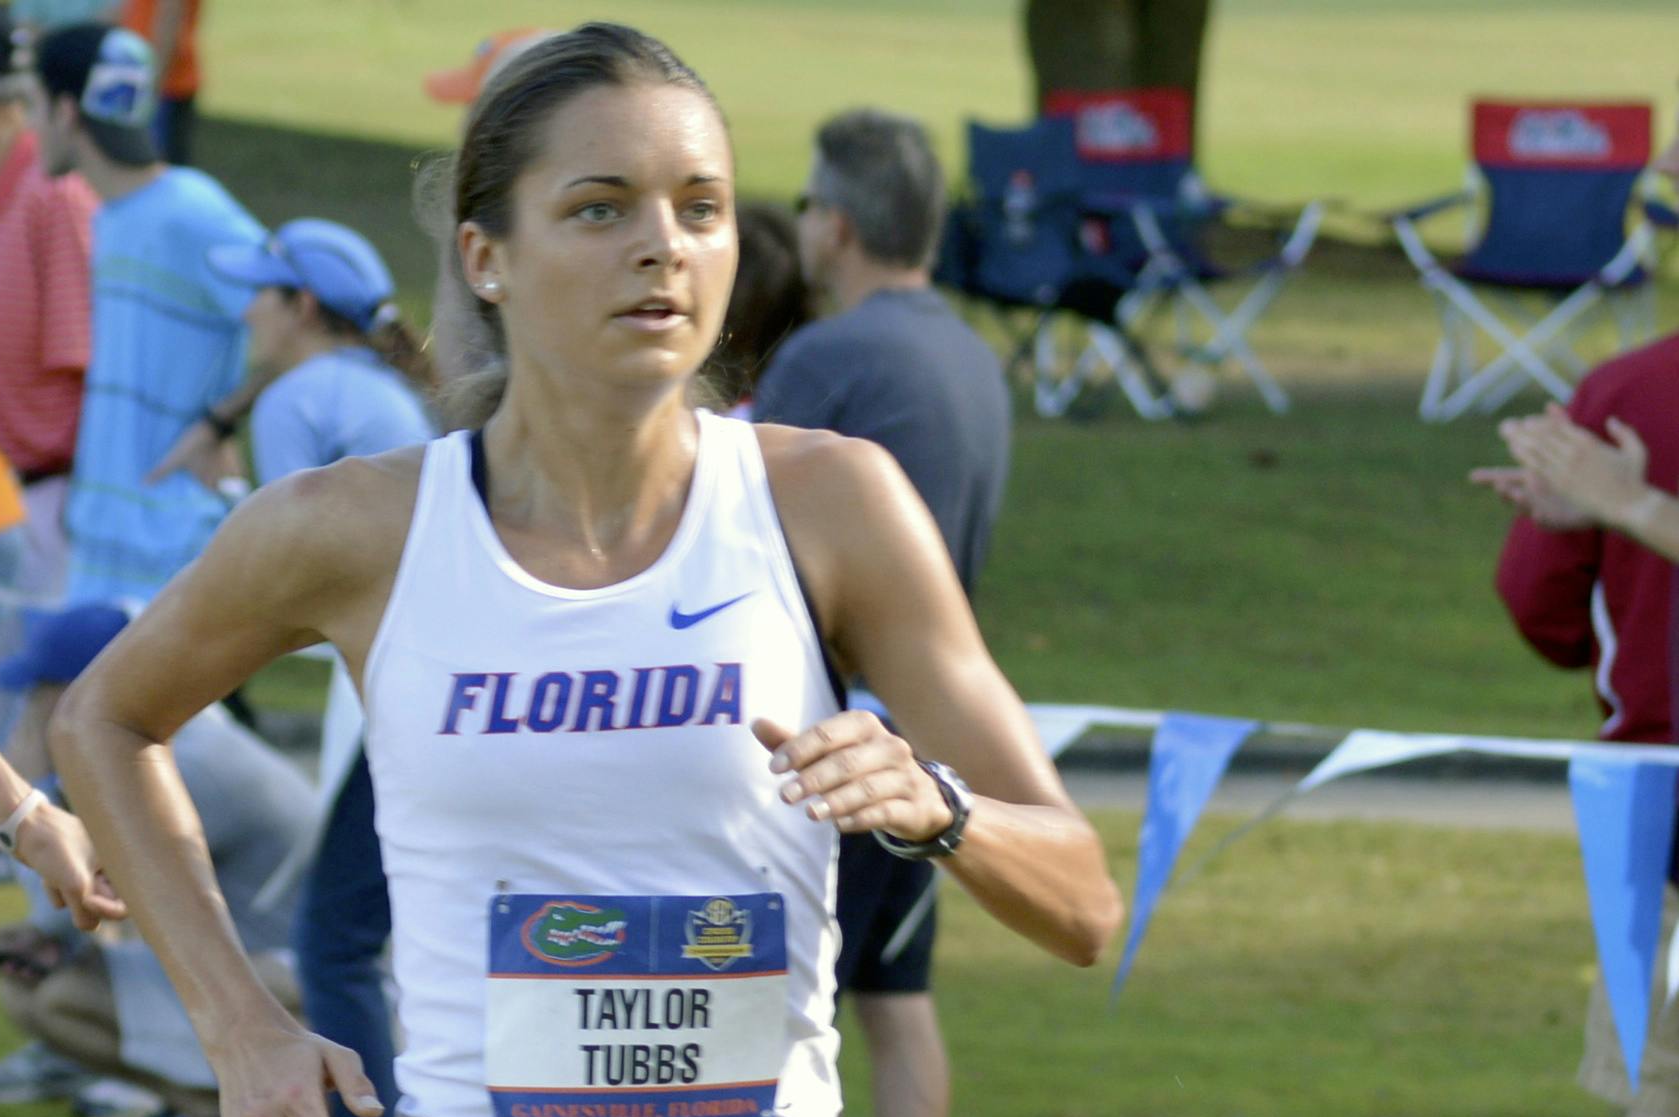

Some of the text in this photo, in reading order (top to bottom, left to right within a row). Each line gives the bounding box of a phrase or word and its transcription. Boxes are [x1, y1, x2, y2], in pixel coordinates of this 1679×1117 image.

[436, 662, 745, 735] FLORIDA
[575, 988, 711, 1030] TAYLOR
[579, 1043, 702, 1085] TUBBS
